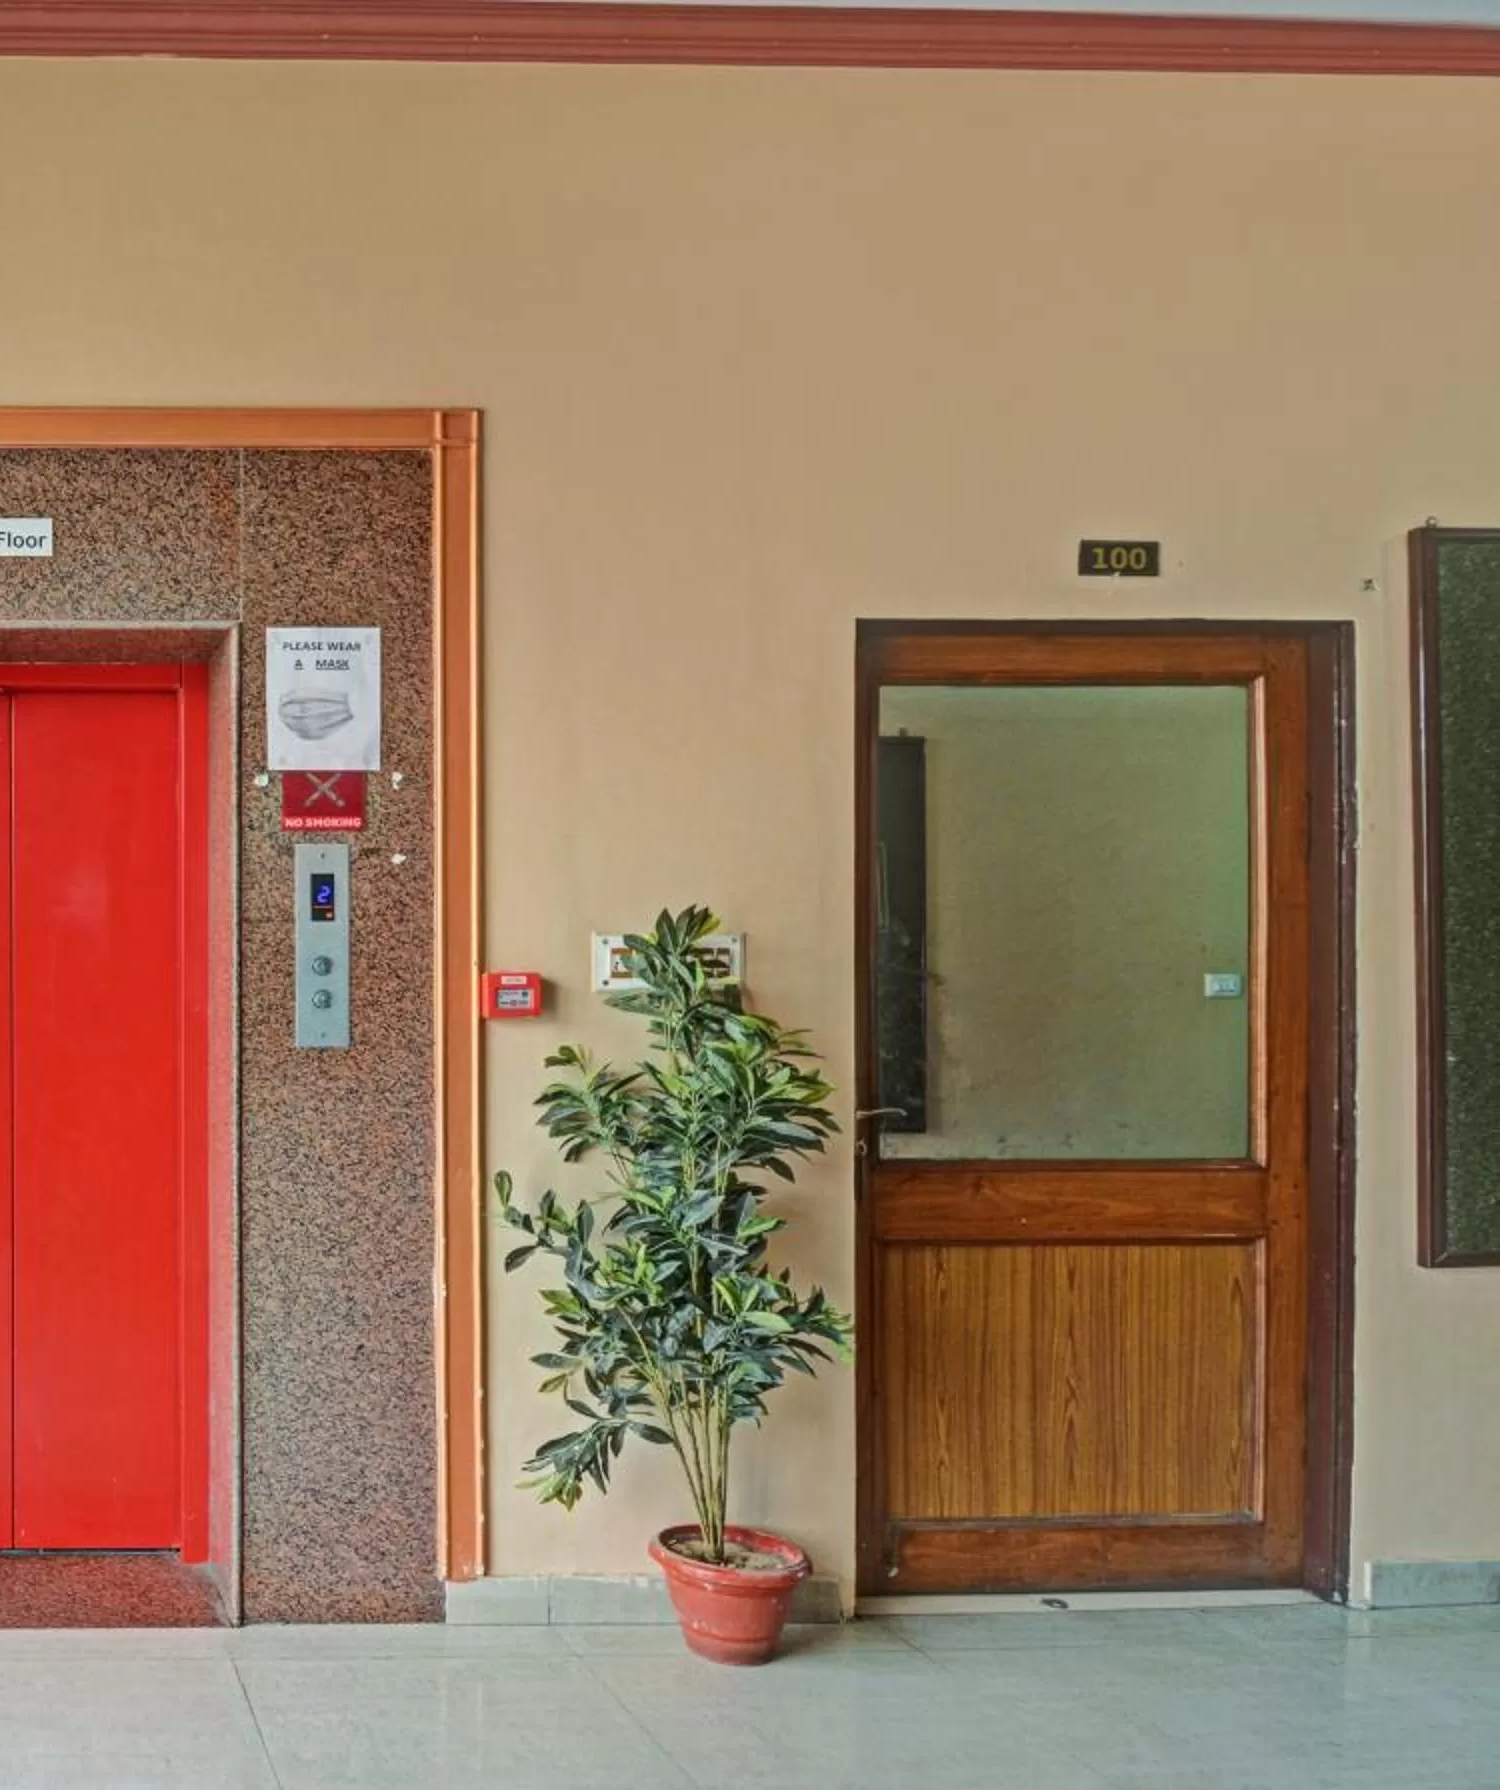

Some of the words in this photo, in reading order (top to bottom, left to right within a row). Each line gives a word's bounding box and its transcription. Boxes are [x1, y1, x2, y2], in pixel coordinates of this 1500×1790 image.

[1091, 546, 1147, 570] 100
[282, 641, 323, 651] PLEASE
[326, 641, 362, 651] WEAR
[294, 659, 303, 670] A
[315, 659, 350, 670] MASK
[285, 818, 303, 827] NO
[305, 817, 362, 827] SMOKING
[316, 885, 331, 903] 2
